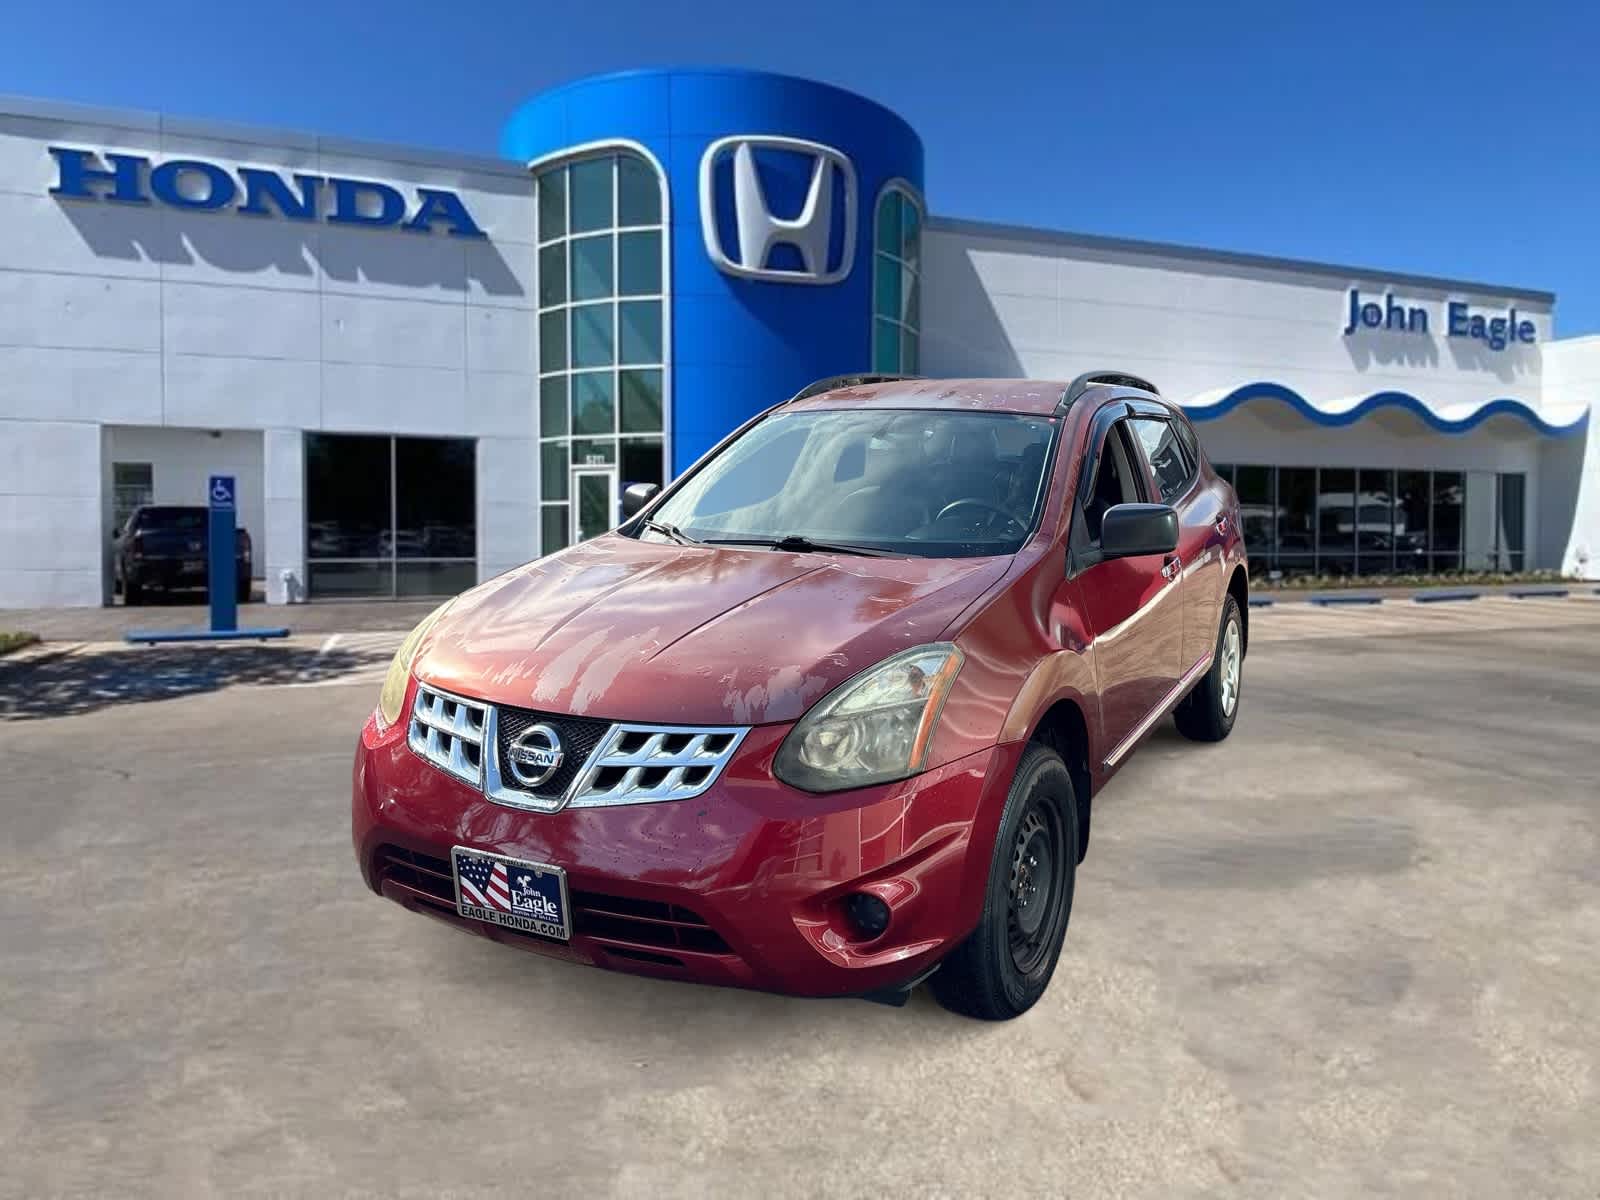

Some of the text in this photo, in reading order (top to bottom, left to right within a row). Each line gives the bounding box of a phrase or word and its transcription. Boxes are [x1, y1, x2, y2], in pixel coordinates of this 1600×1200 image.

[48, 146, 488, 238] HONDA
[1344, 289, 1536, 351] John Eagle
[508, 746, 555, 764] NISSAN
[511, 889, 558, 915] Eagle
[523, 887, 541, 897] John
[462, 905, 566, 938] EAGLE HONDA.COM
